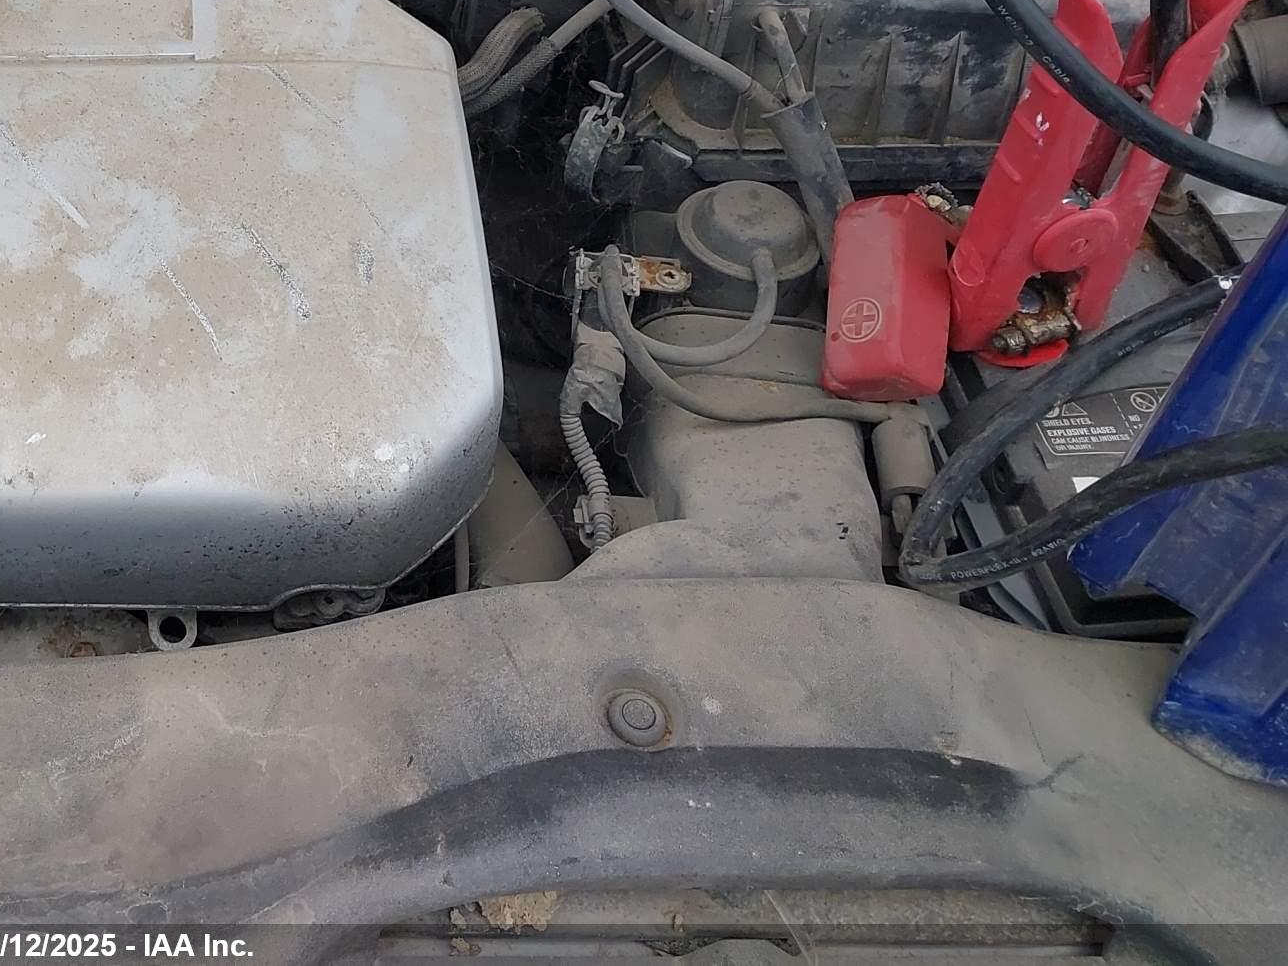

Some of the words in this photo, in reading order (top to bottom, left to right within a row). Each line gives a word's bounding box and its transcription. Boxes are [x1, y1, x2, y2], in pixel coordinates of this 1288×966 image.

[1041, 418, 1070, 427] SHIELD
[1046, 427, 1090, 437] EXPLOSIVE
[1091, 426, 1116, 435] GASES
[1067, 435, 1090, 443] CAUSE
[1091, 433, 1130, 442] BLINDNESS
